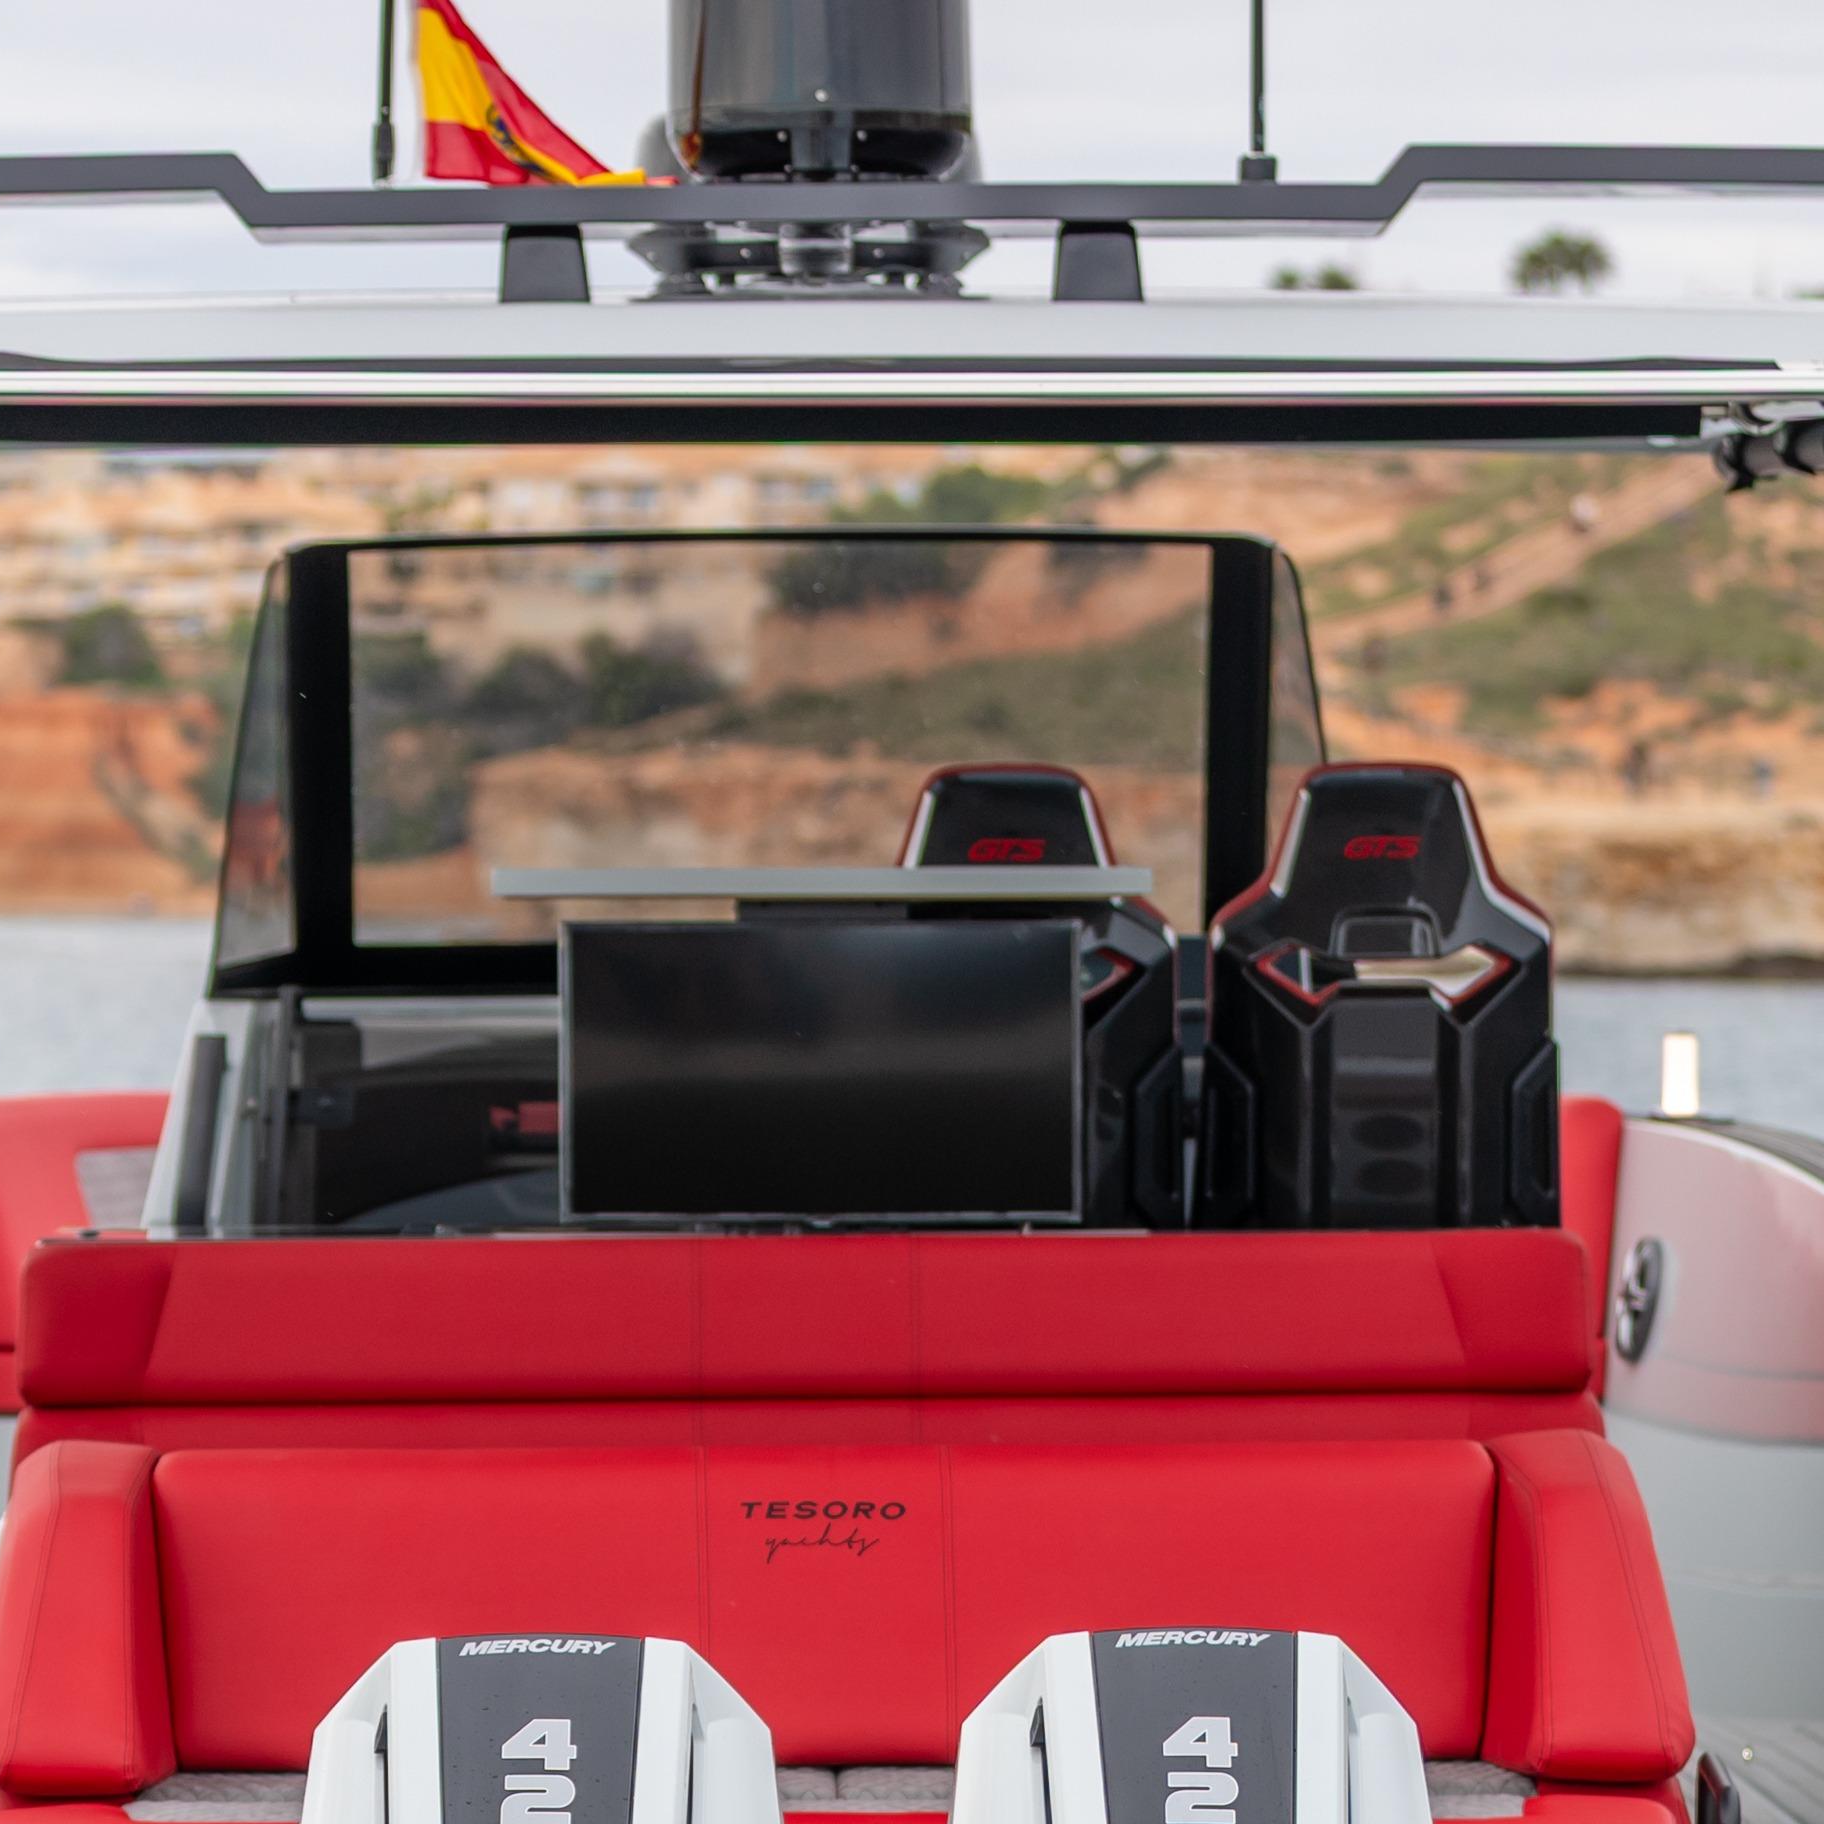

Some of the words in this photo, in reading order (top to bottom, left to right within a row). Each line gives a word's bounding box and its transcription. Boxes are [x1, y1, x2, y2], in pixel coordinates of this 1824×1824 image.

[968, 837, 1046, 862] GTS
[1343, 834, 1423, 860] GTS
[741, 1501, 906, 1520] TESORO
[765, 1523, 879, 1564] yachts
[459, 1638, 616, 1657] MERCURY
[1115, 1630, 1271, 1648] MERCURY
